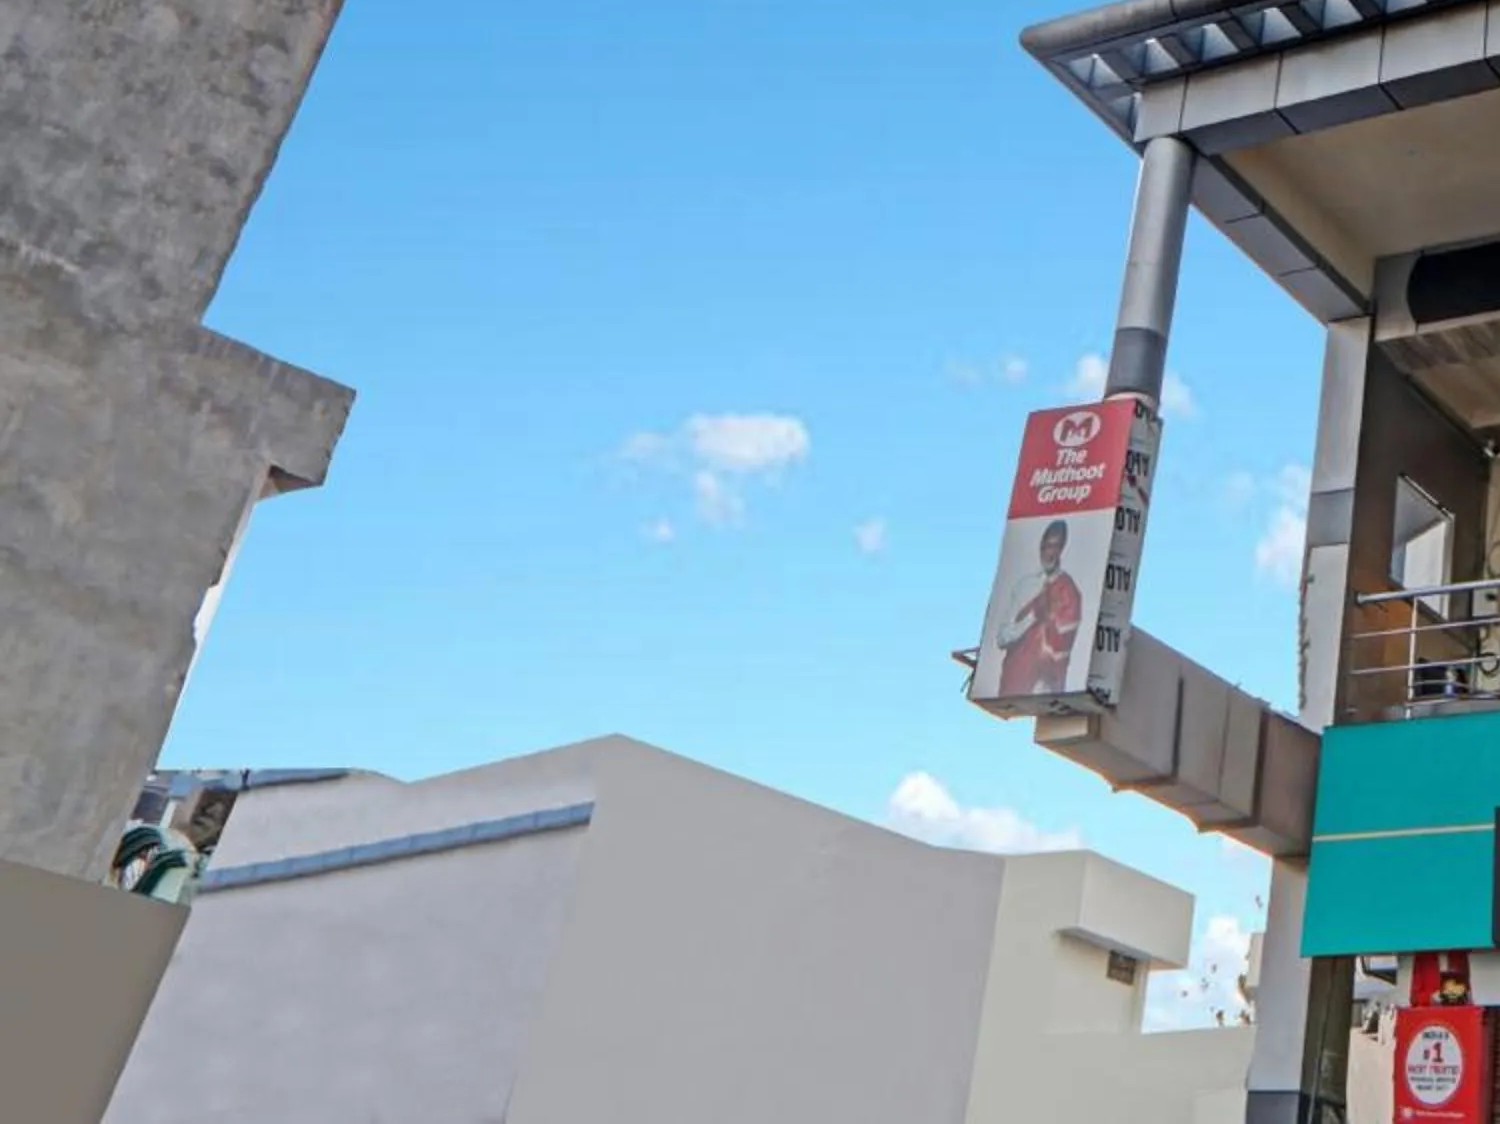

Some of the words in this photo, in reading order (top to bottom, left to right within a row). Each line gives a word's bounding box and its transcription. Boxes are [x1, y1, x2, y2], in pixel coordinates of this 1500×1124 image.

[1056, 447, 1088, 467] The
[1029, 462, 1105, 487] Muthoot
[1038, 483, 1092, 504] Group
